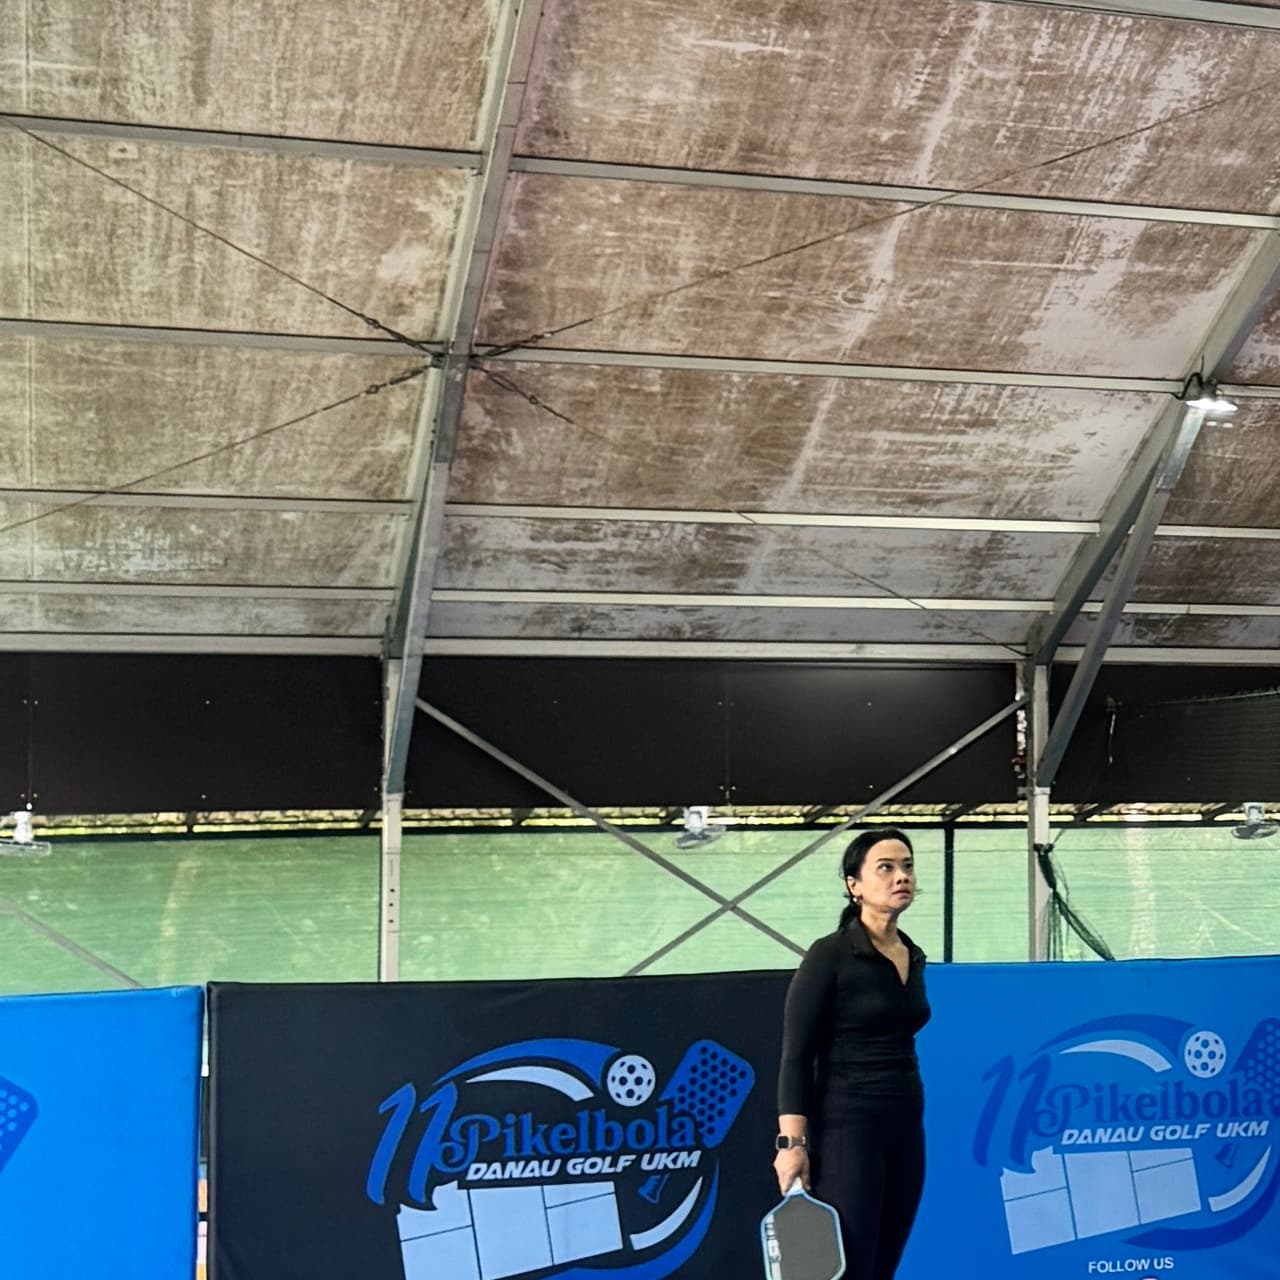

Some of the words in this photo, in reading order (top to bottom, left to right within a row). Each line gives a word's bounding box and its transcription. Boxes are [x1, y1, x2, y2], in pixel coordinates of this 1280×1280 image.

[1060, 1126, 1144, 1145] DANAU
[1149, 1123, 1211, 1141] GOLF
[1215, 1120, 1270, 1138] UKM
[466, 1160, 561, 1181] DANAU
[566, 1154, 635, 1176] GOLF
[640, 1150, 702, 1171] UKM
[1088, 1258, 1151, 1274] FOLLOW
[1153, 1257, 1174, 1269] US
